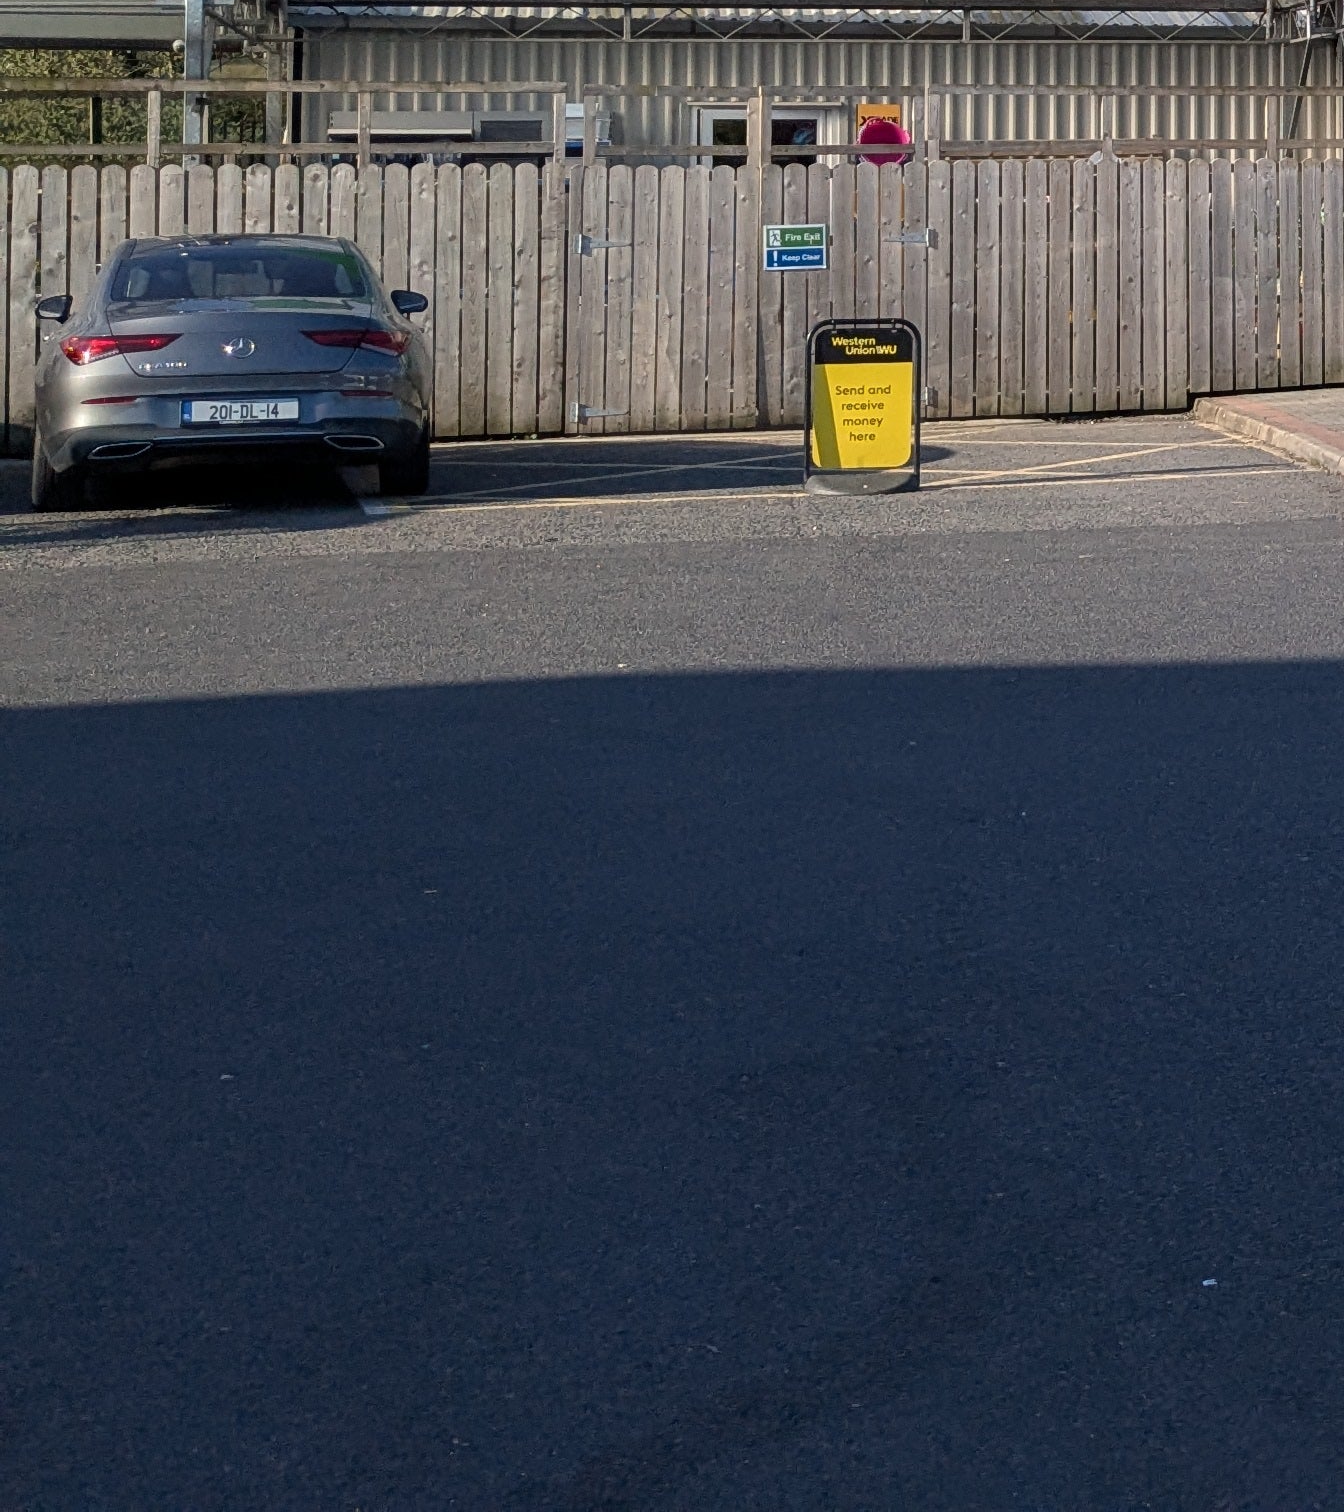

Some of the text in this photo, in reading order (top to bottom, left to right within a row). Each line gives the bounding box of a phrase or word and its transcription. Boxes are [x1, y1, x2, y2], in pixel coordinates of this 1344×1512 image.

[804, 233, 821, 241] Exit
[782, 254, 800, 262] Keep
[832, 336, 876, 346] Western
[845, 346, 876, 355] Union
[835, 385, 891, 395] Send and
[842, 400, 885, 410] receive
[209, 403, 279, 420] 201-DL-14
[843, 418, 883, 427] money
[849, 432, 876, 441] here
